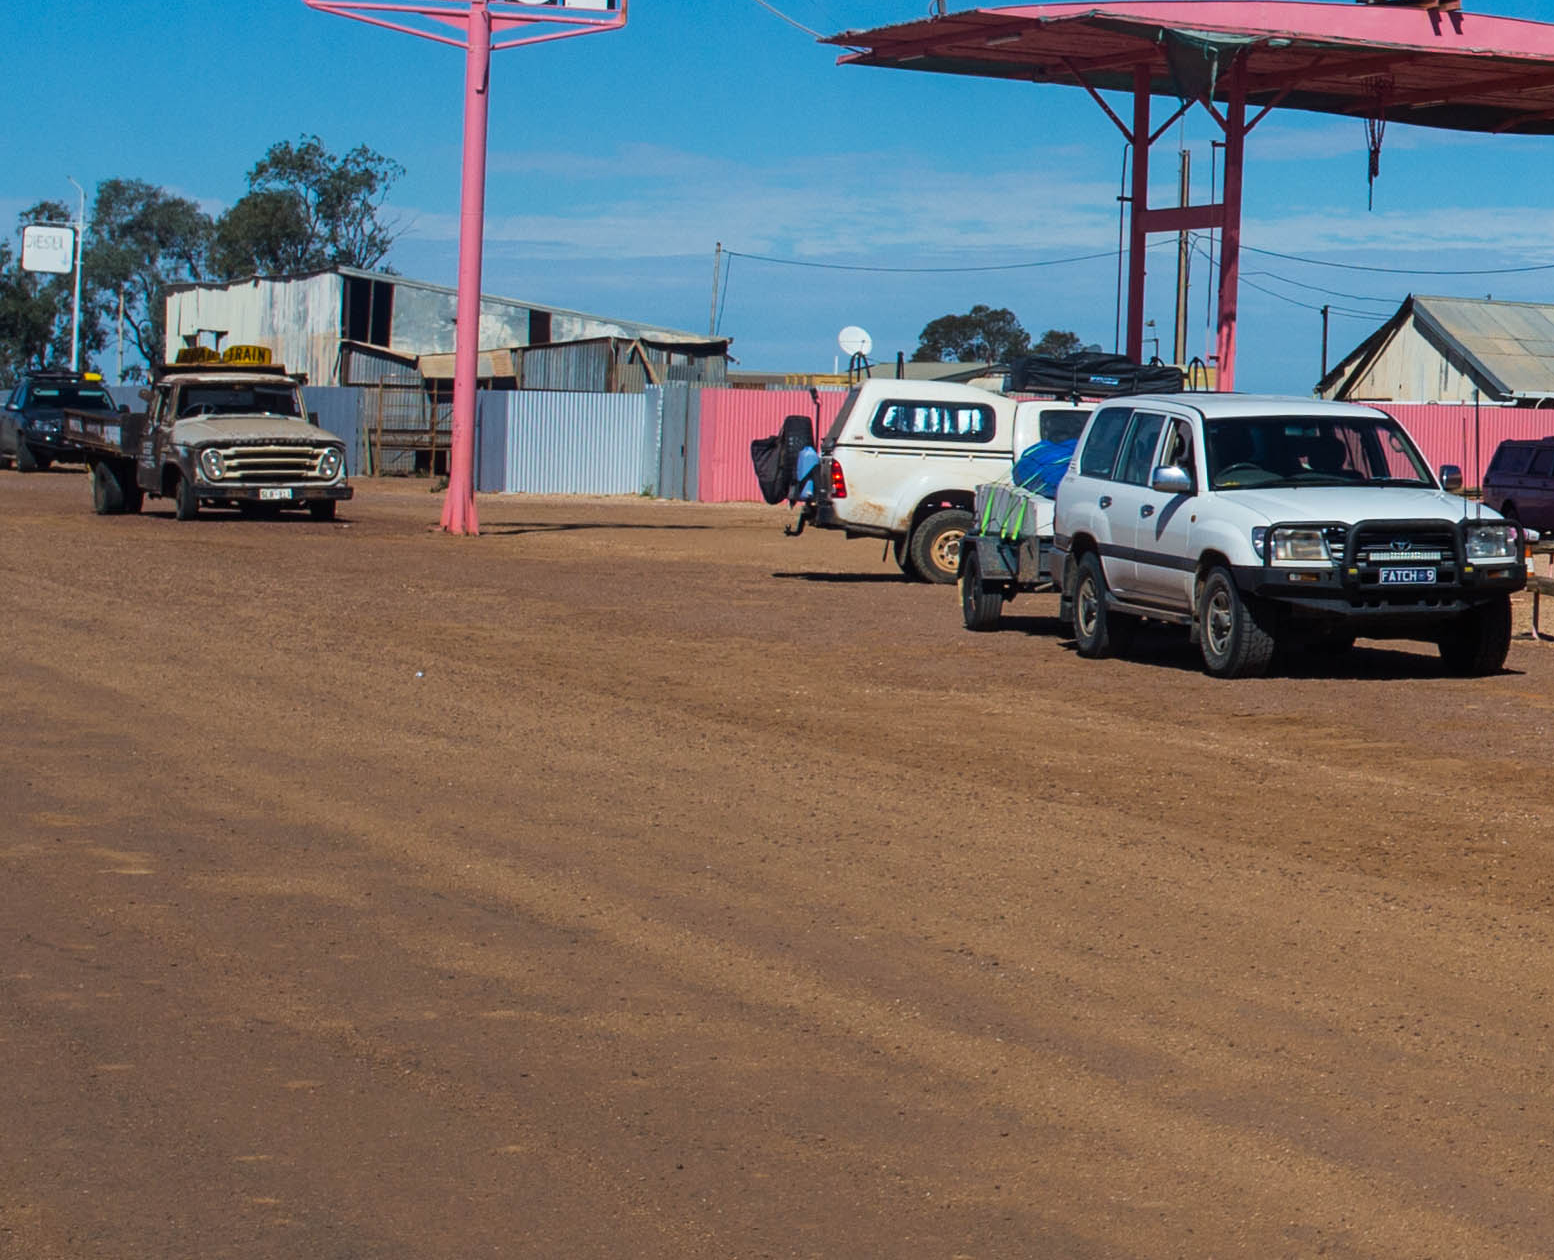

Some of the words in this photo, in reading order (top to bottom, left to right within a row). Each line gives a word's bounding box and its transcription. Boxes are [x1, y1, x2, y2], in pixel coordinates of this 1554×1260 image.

[229, 346, 265, 362] TRAIN
[1382, 570, 1417, 582] FATCH
[1427, 570, 1435, 581] 9
